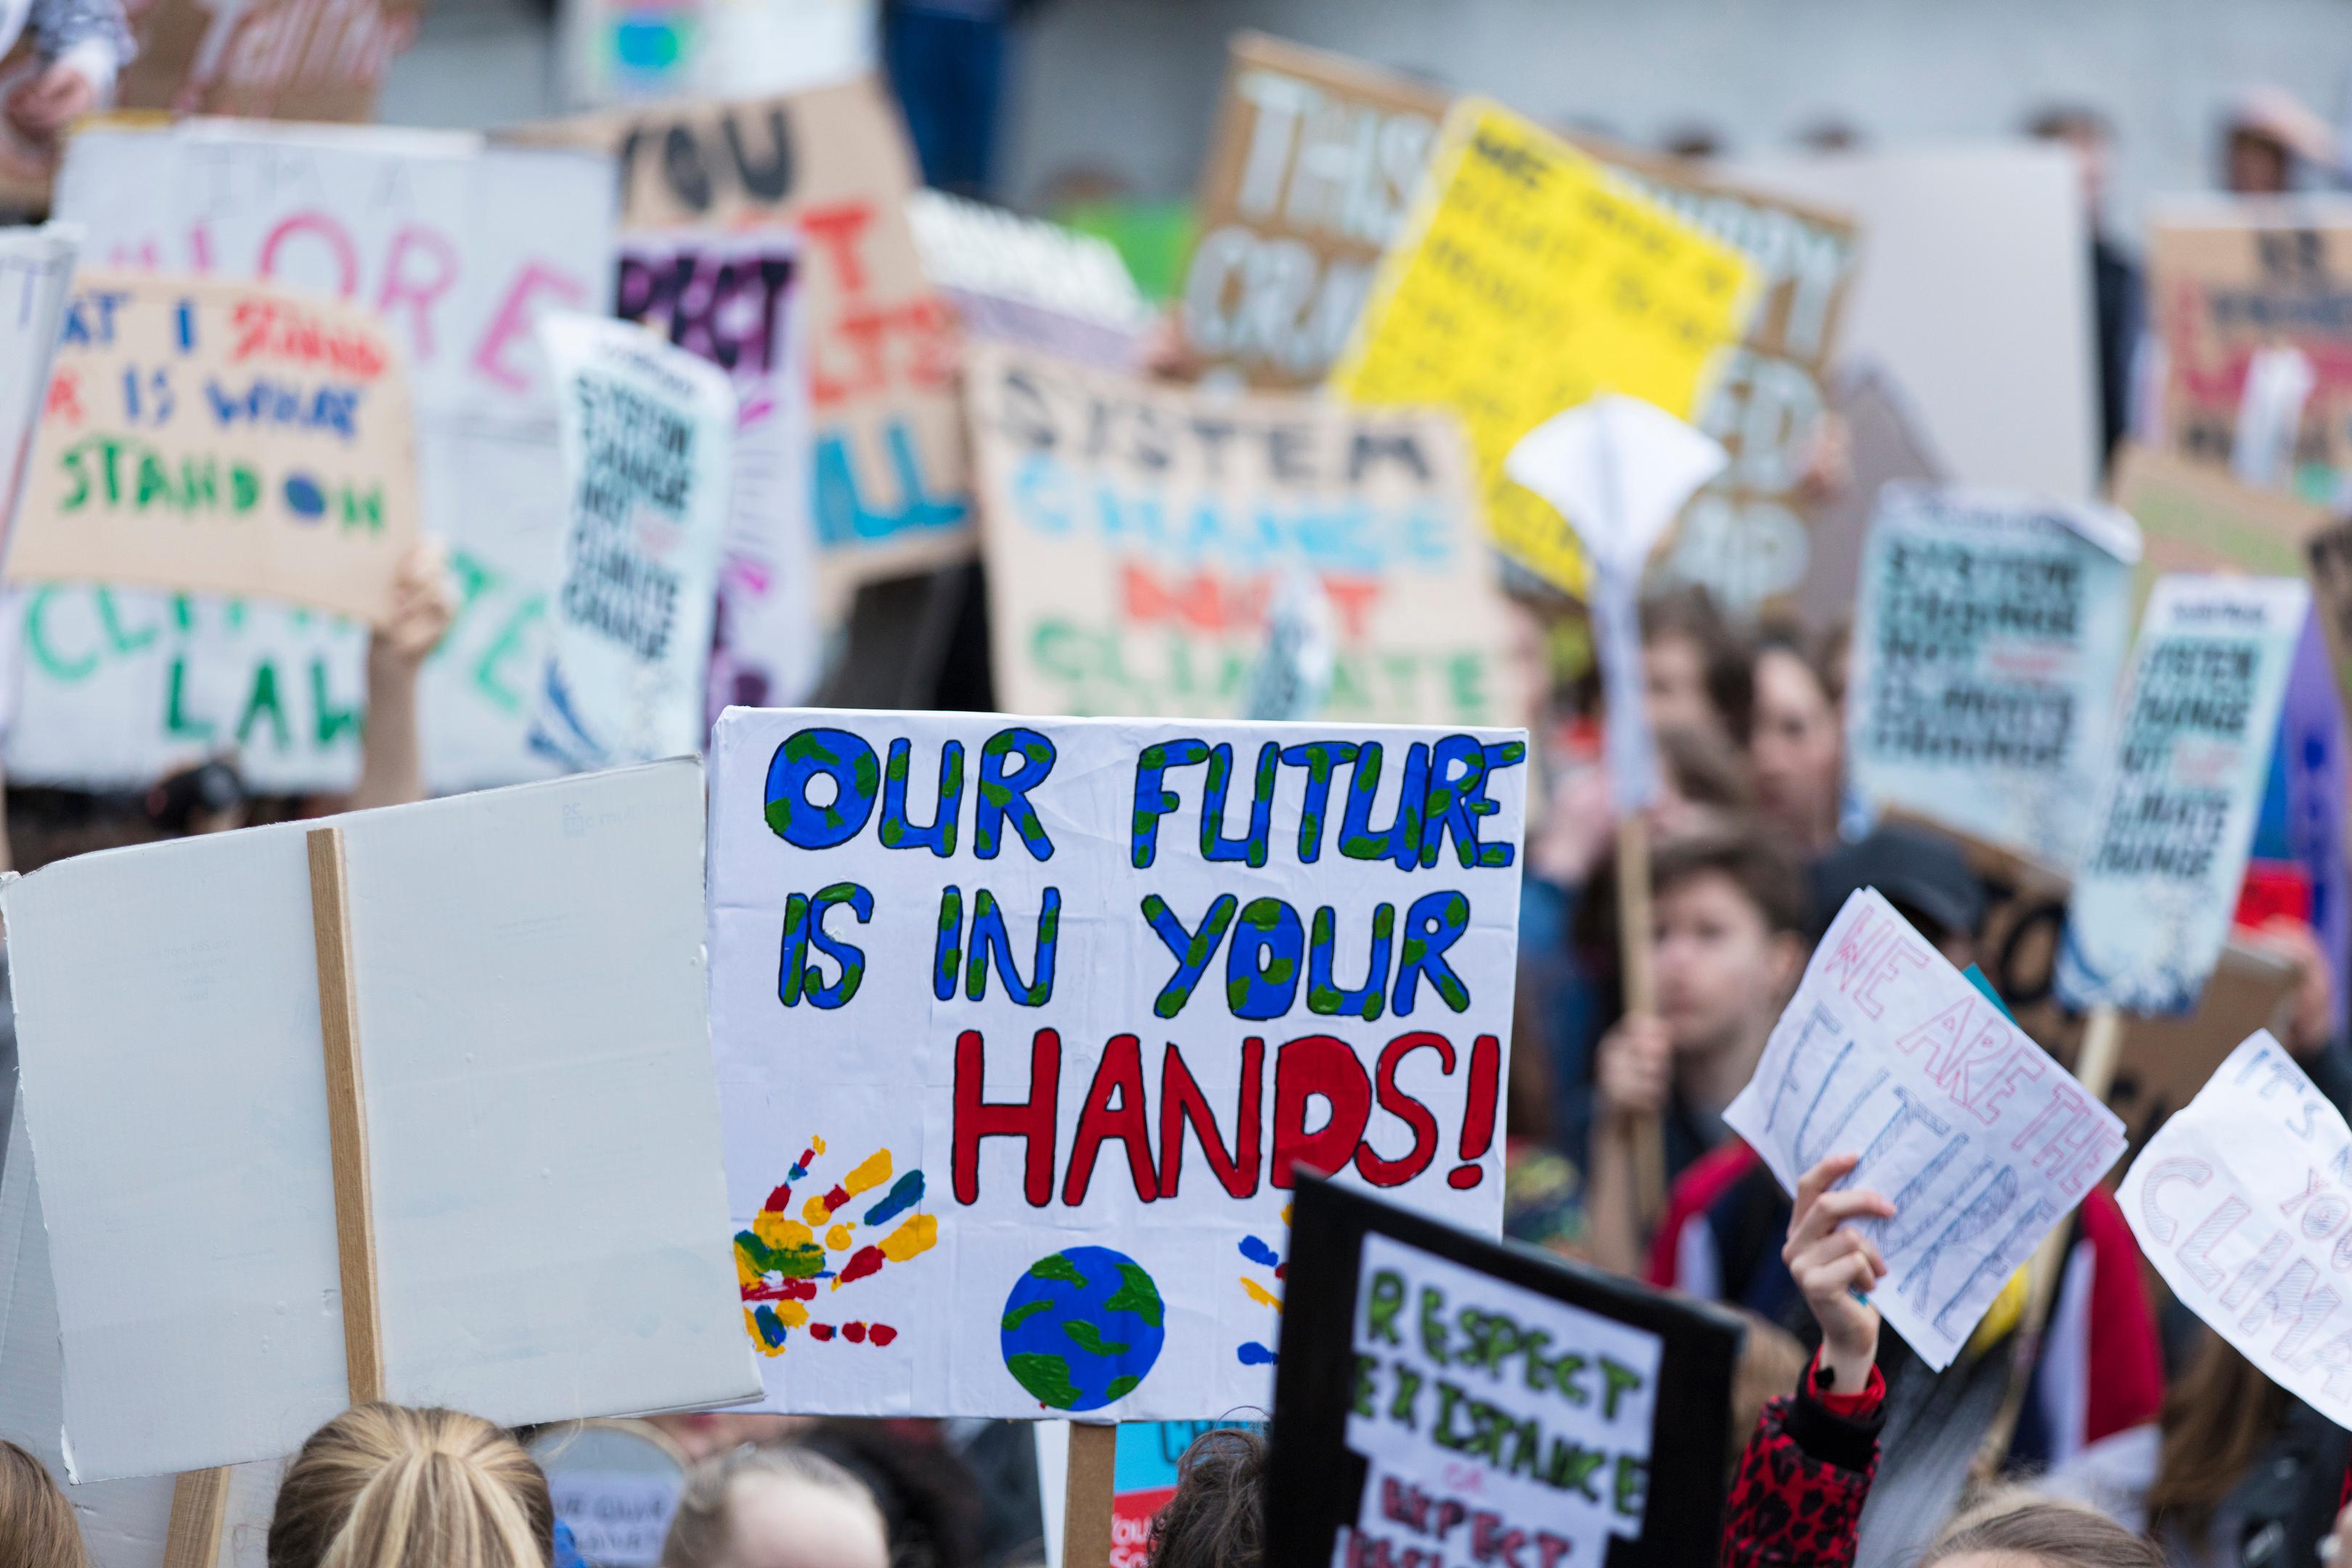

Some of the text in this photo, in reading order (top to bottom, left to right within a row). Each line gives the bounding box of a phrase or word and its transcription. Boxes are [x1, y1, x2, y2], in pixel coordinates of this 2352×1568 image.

[58, 434, 264, 517] STAND
[1000, 367, 1432, 485] SYSTEM
[1010, 452, 1453, 573] CHANGE
[764, 727, 1526, 871] OUR FUTURE
[777, 882, 1471, 1021] IS IN YOUR
[952, 1027, 1500, 1208] HANDS!
[1824, 905, 1931, 1021] WE
[1896, 993, 2046, 1127] ARE
[2011, 1082, 2123, 1196] THE
[1764, 1000, 2059, 1344] FUTURE
[1367, 1269, 1641, 1421] RESPECT
